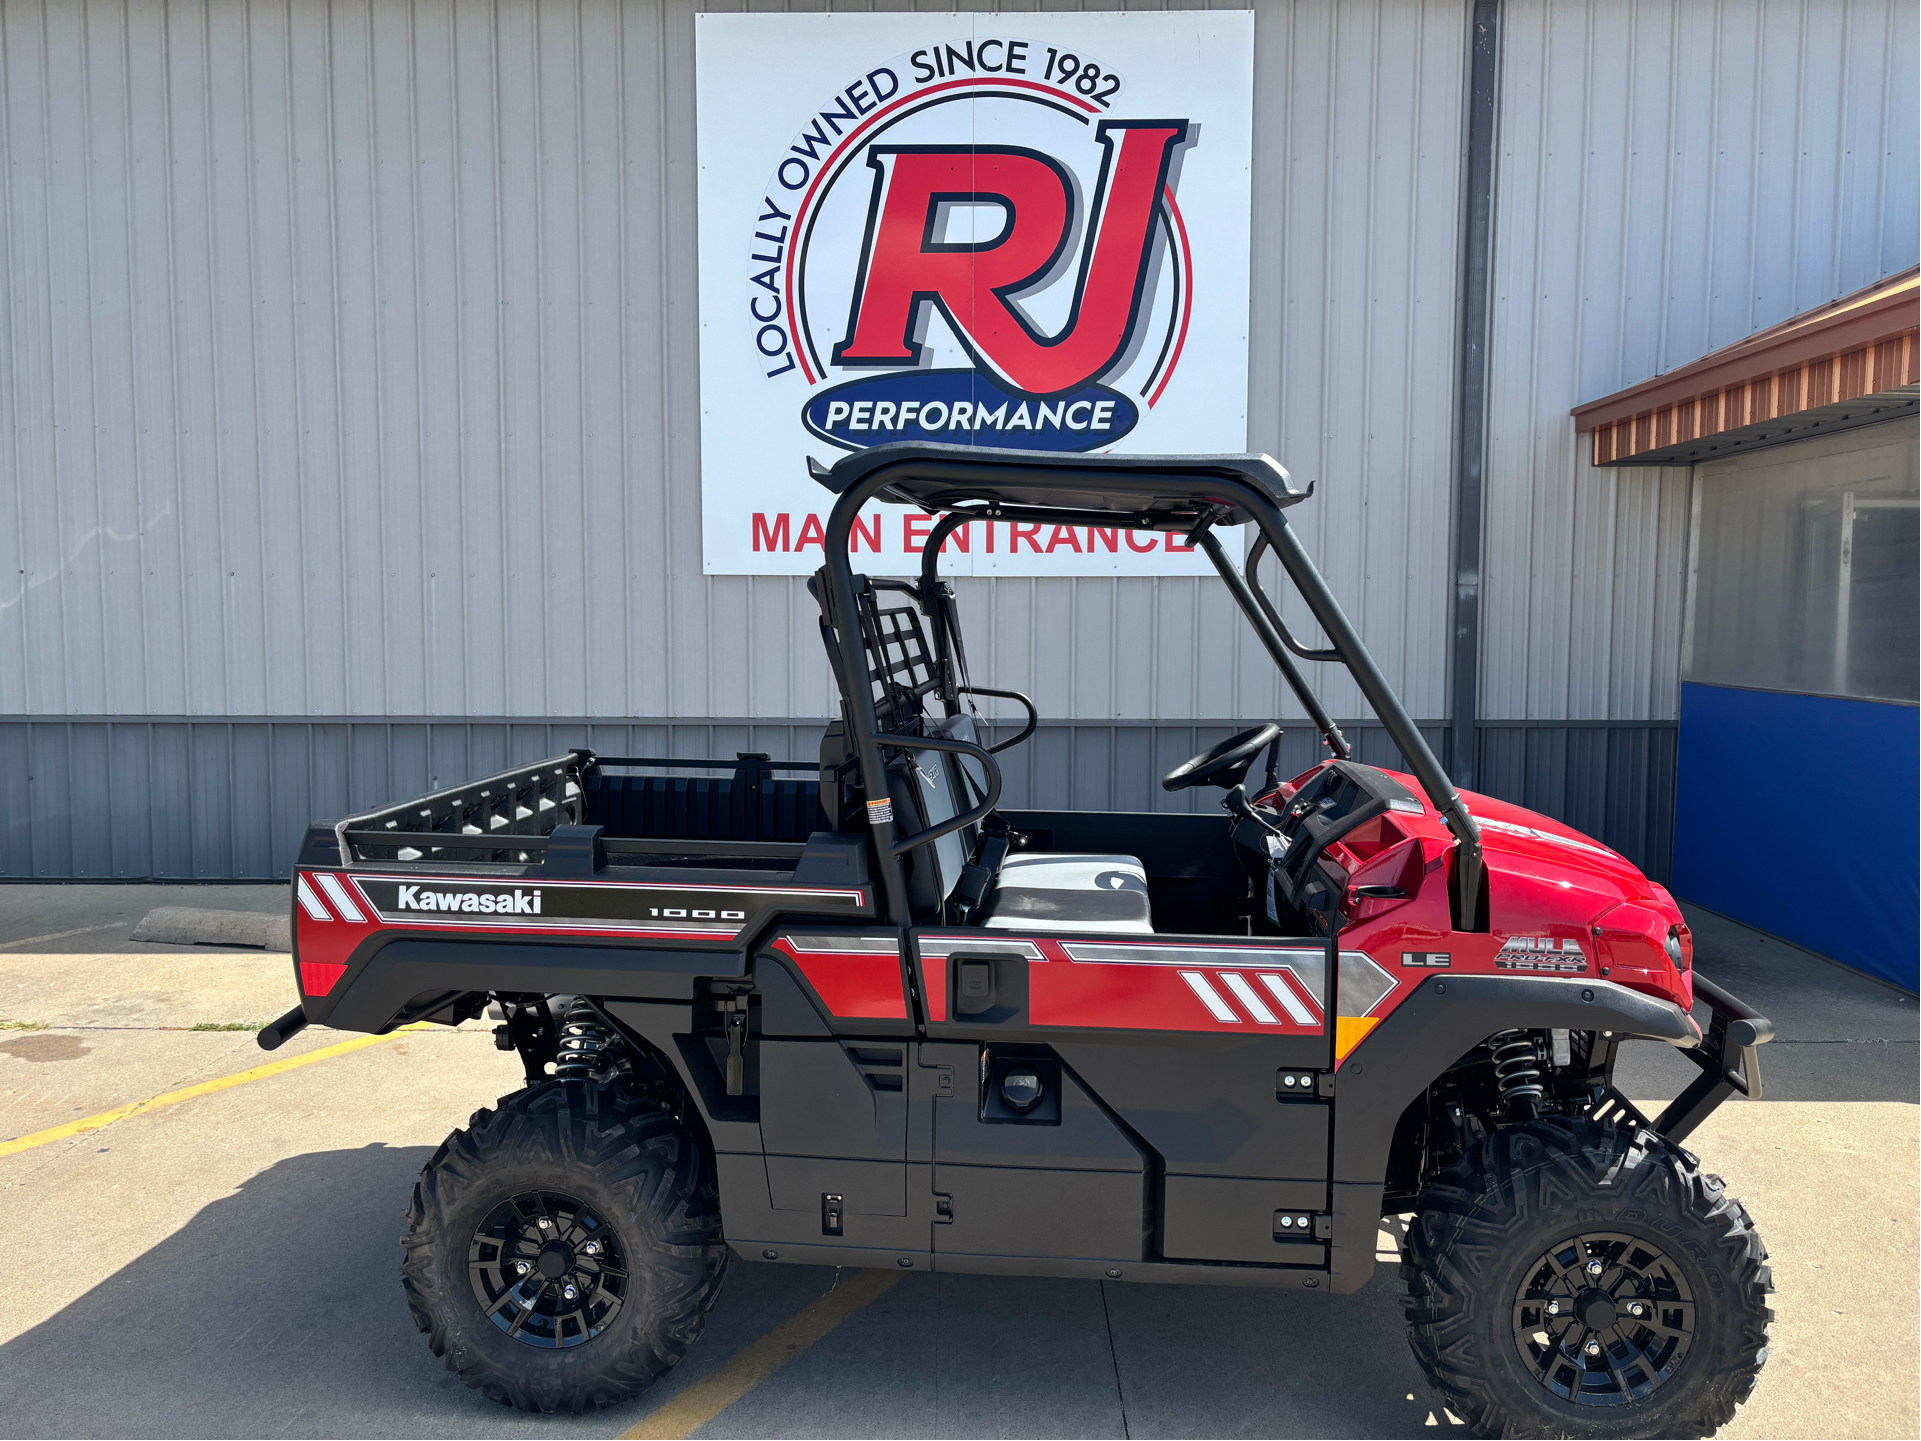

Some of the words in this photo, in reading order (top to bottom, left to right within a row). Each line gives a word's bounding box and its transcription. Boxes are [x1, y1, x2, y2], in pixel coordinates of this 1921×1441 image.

[750, 196, 796, 378] LOCALLY
[777, 67, 899, 190] OWNED
[910, 39, 1029, 84] SINCE
[1044, 48, 1121, 108] 1982
[830, 118, 1190, 400] RJ
[824, 400, 1116, 431] PERFORMANCE
[752, 512, 882, 553] MAN
[398, 885, 541, 914] Kawasaki
[649, 907, 745, 919] 1000
[1402, 953, 1450, 966] LE
[1500, 936, 1585, 955] MULE
[1615, 1207, 1725, 1291] DURO
